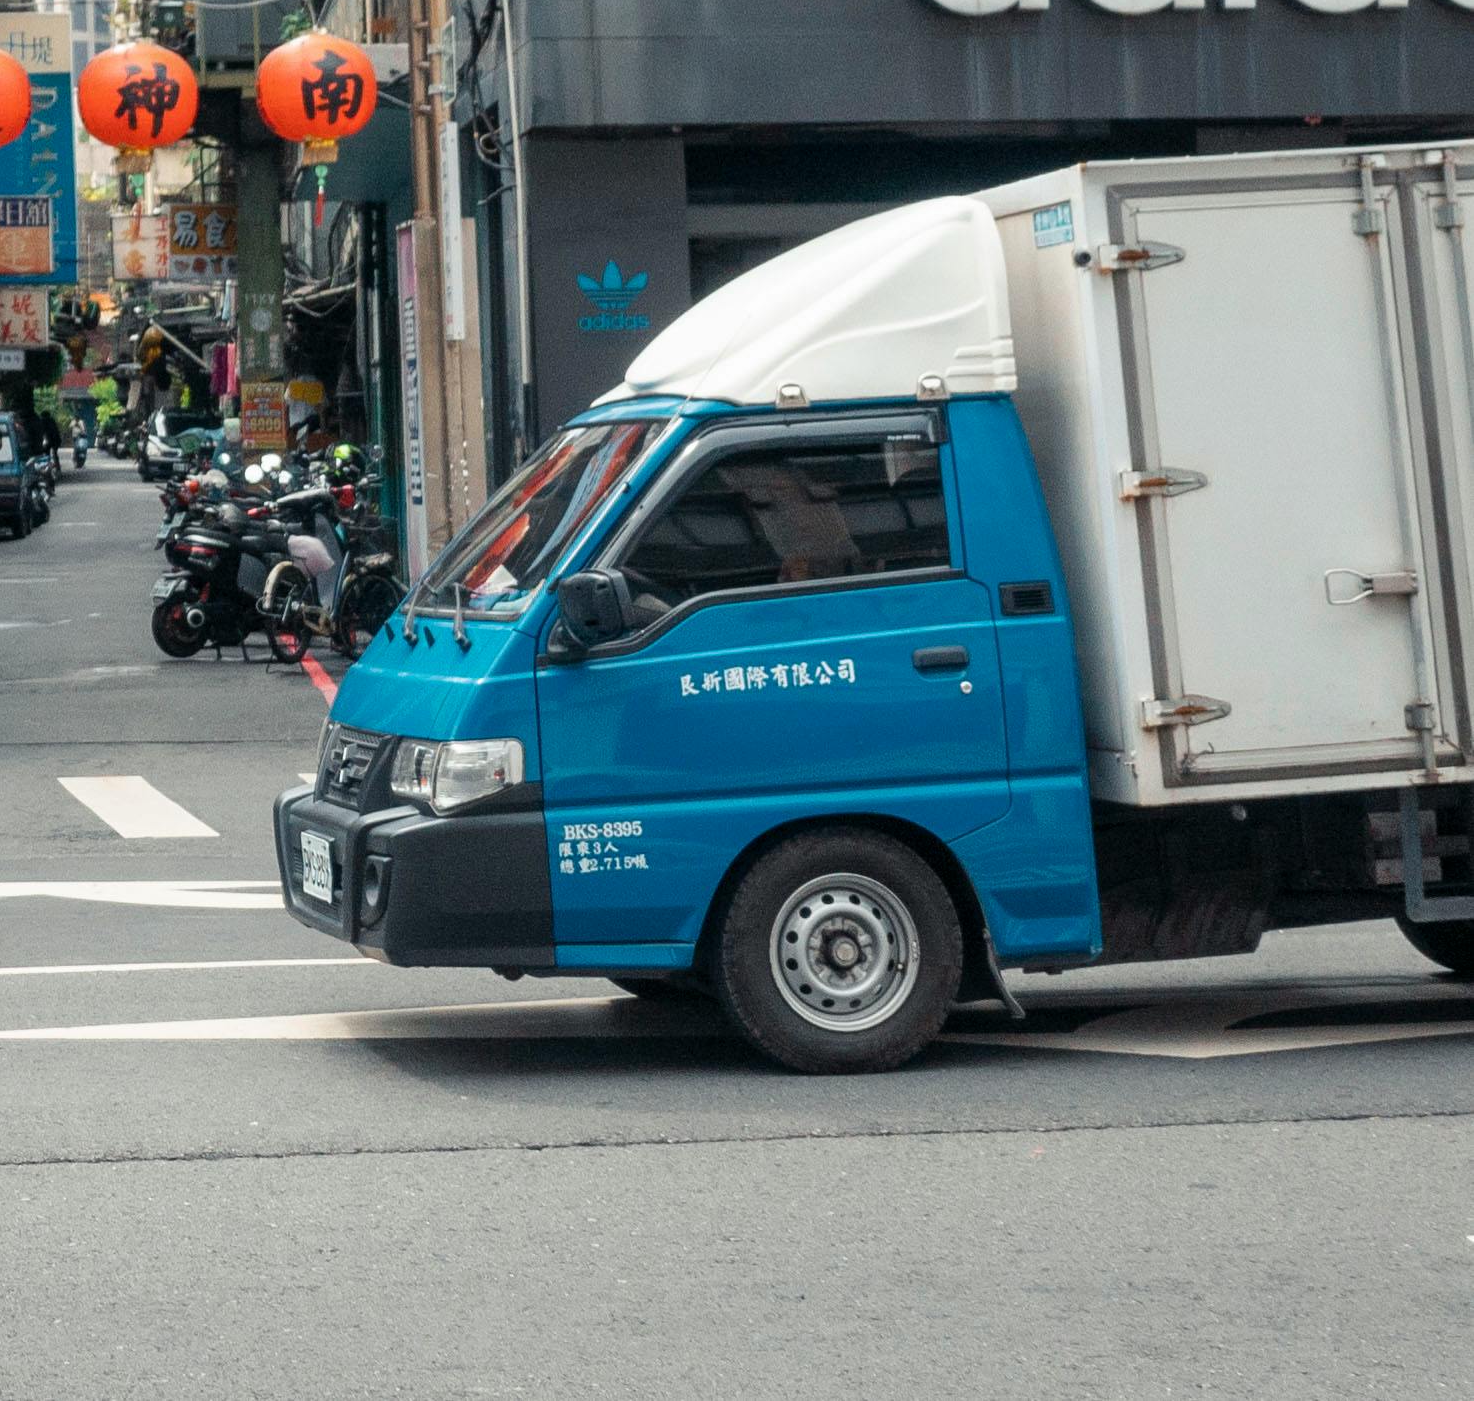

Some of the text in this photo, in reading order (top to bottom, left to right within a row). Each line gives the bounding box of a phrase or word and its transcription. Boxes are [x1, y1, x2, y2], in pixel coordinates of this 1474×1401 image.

[116, 64, 180, 138] 神
[301, 50, 365, 125] 南
[577, 312, 650, 331] adidas
[564, 820, 643, 840] BKS-8395
